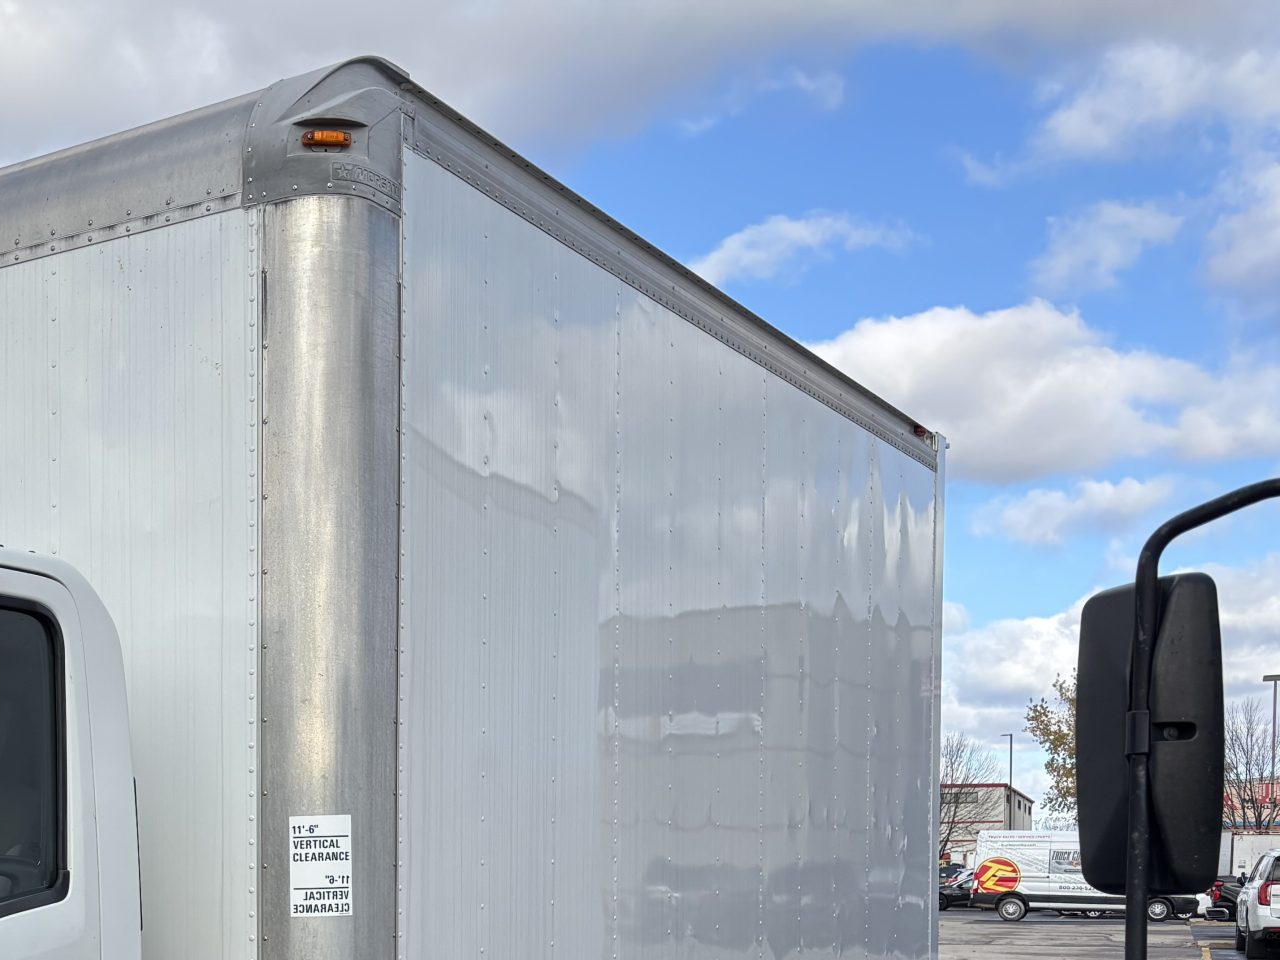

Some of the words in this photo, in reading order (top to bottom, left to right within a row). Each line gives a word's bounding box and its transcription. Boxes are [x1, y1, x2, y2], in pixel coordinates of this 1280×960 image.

[293, 839, 341, 850] VERTICAL
[293, 852, 350, 862] CLEARANCE
[1051, 850, 1072, 861] TRUCK
